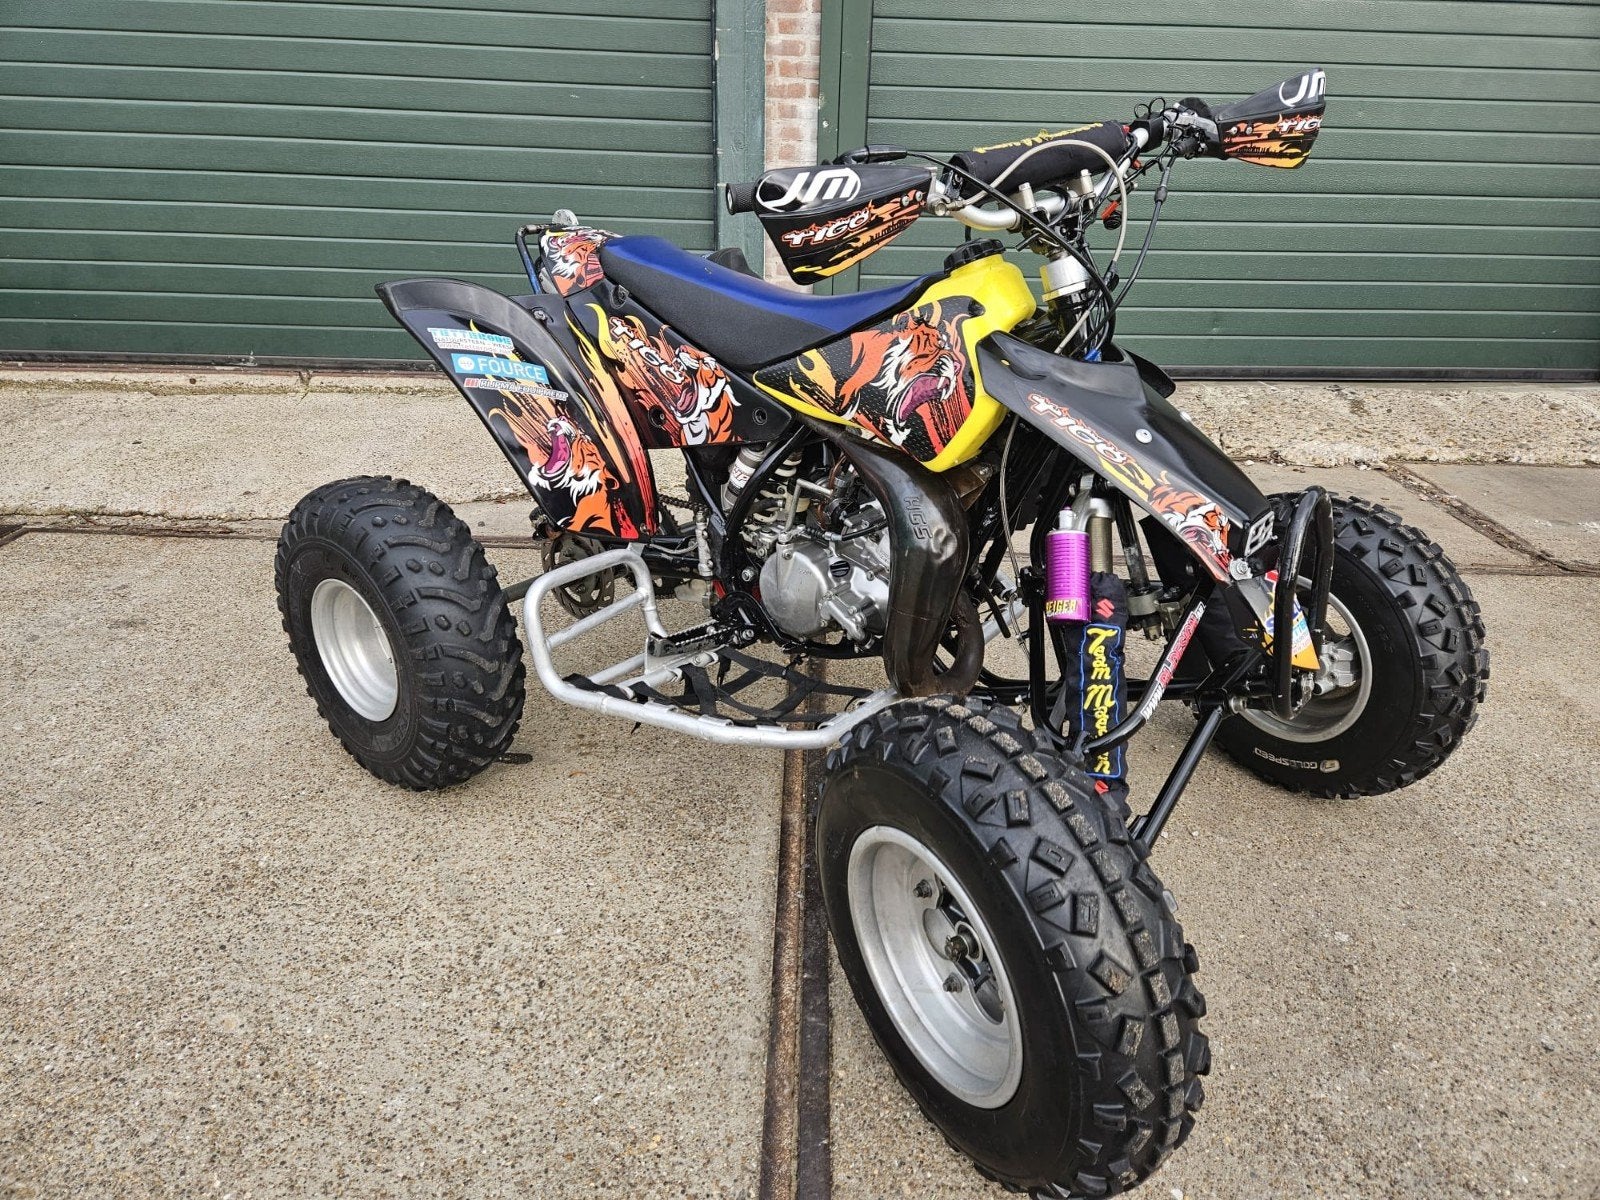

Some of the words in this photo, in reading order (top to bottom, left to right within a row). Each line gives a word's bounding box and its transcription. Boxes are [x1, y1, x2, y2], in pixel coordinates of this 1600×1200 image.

[478, 357, 546, 381] FOURCE
[903, 496, 933, 540] HGS
[1086, 627, 1118, 680] Team
[1254, 747, 1317, 769] GOLDSPEED
